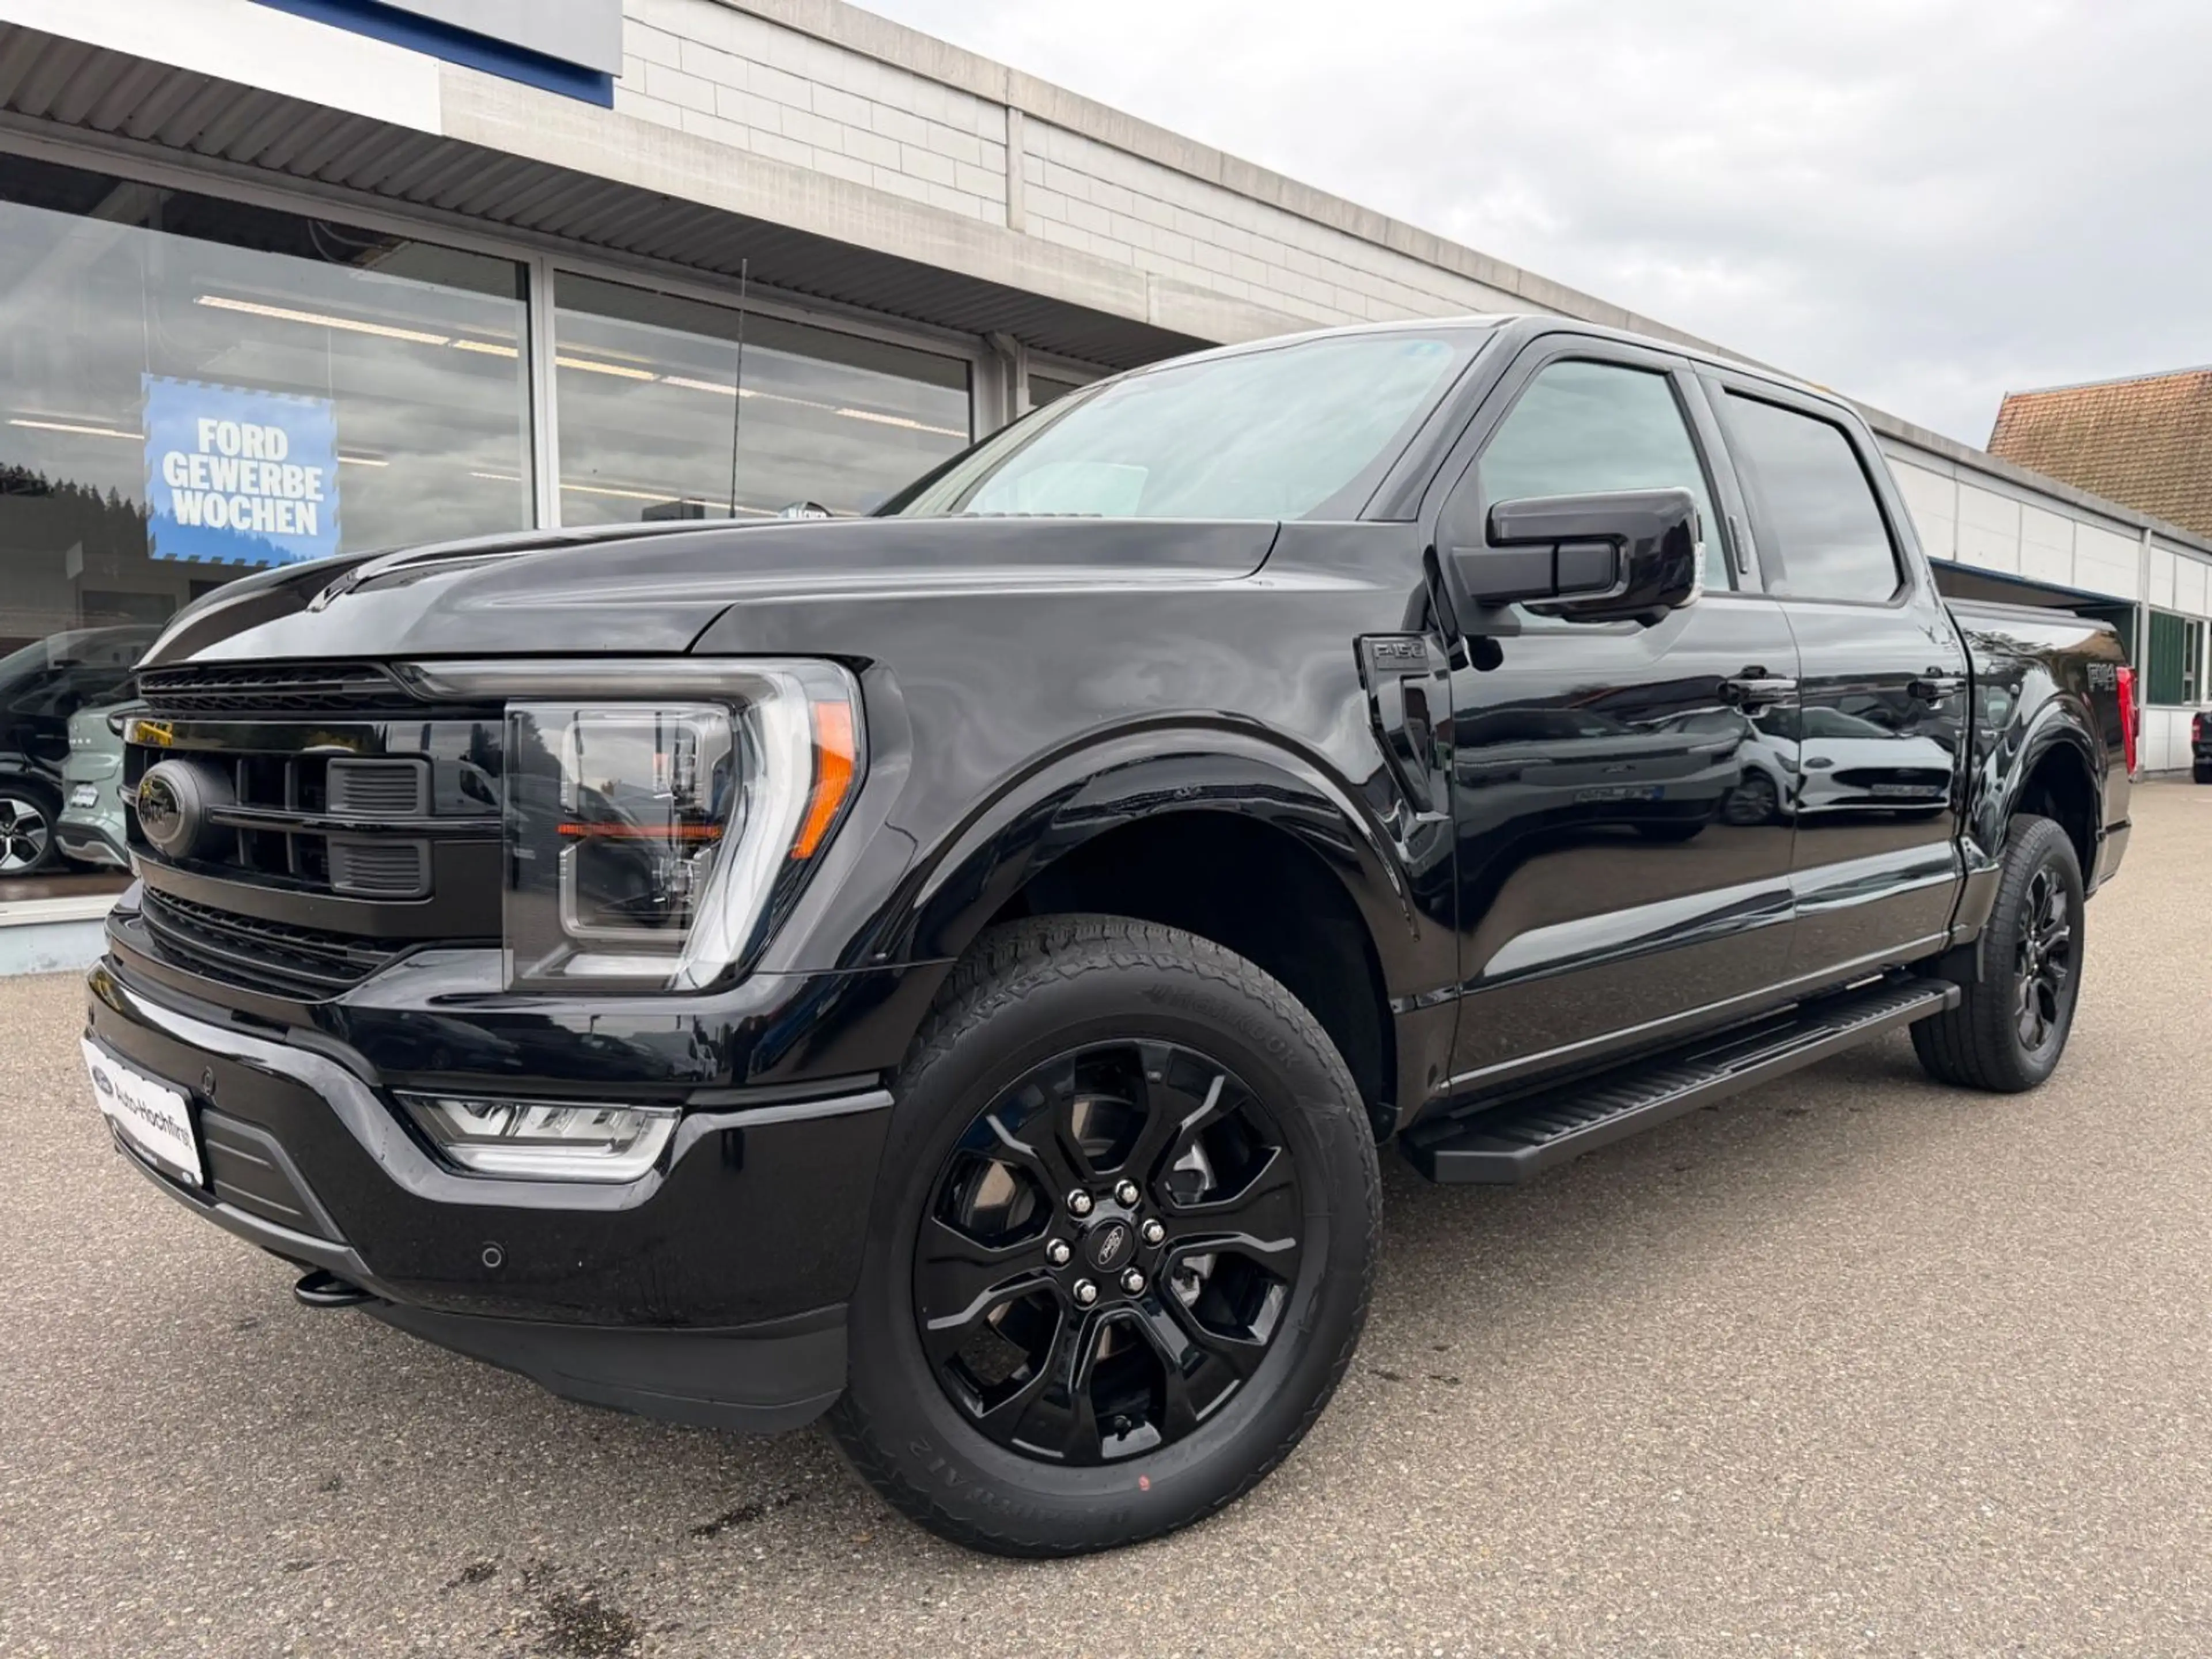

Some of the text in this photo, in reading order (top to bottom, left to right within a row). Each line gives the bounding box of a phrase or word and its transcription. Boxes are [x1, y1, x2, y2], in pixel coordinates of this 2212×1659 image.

[198, 417, 288, 461] FORD
[162, 451, 324, 501] GEWERBE
[172, 489, 317, 536] WOCHEN
[1374, 643, 1426, 658] F-150
